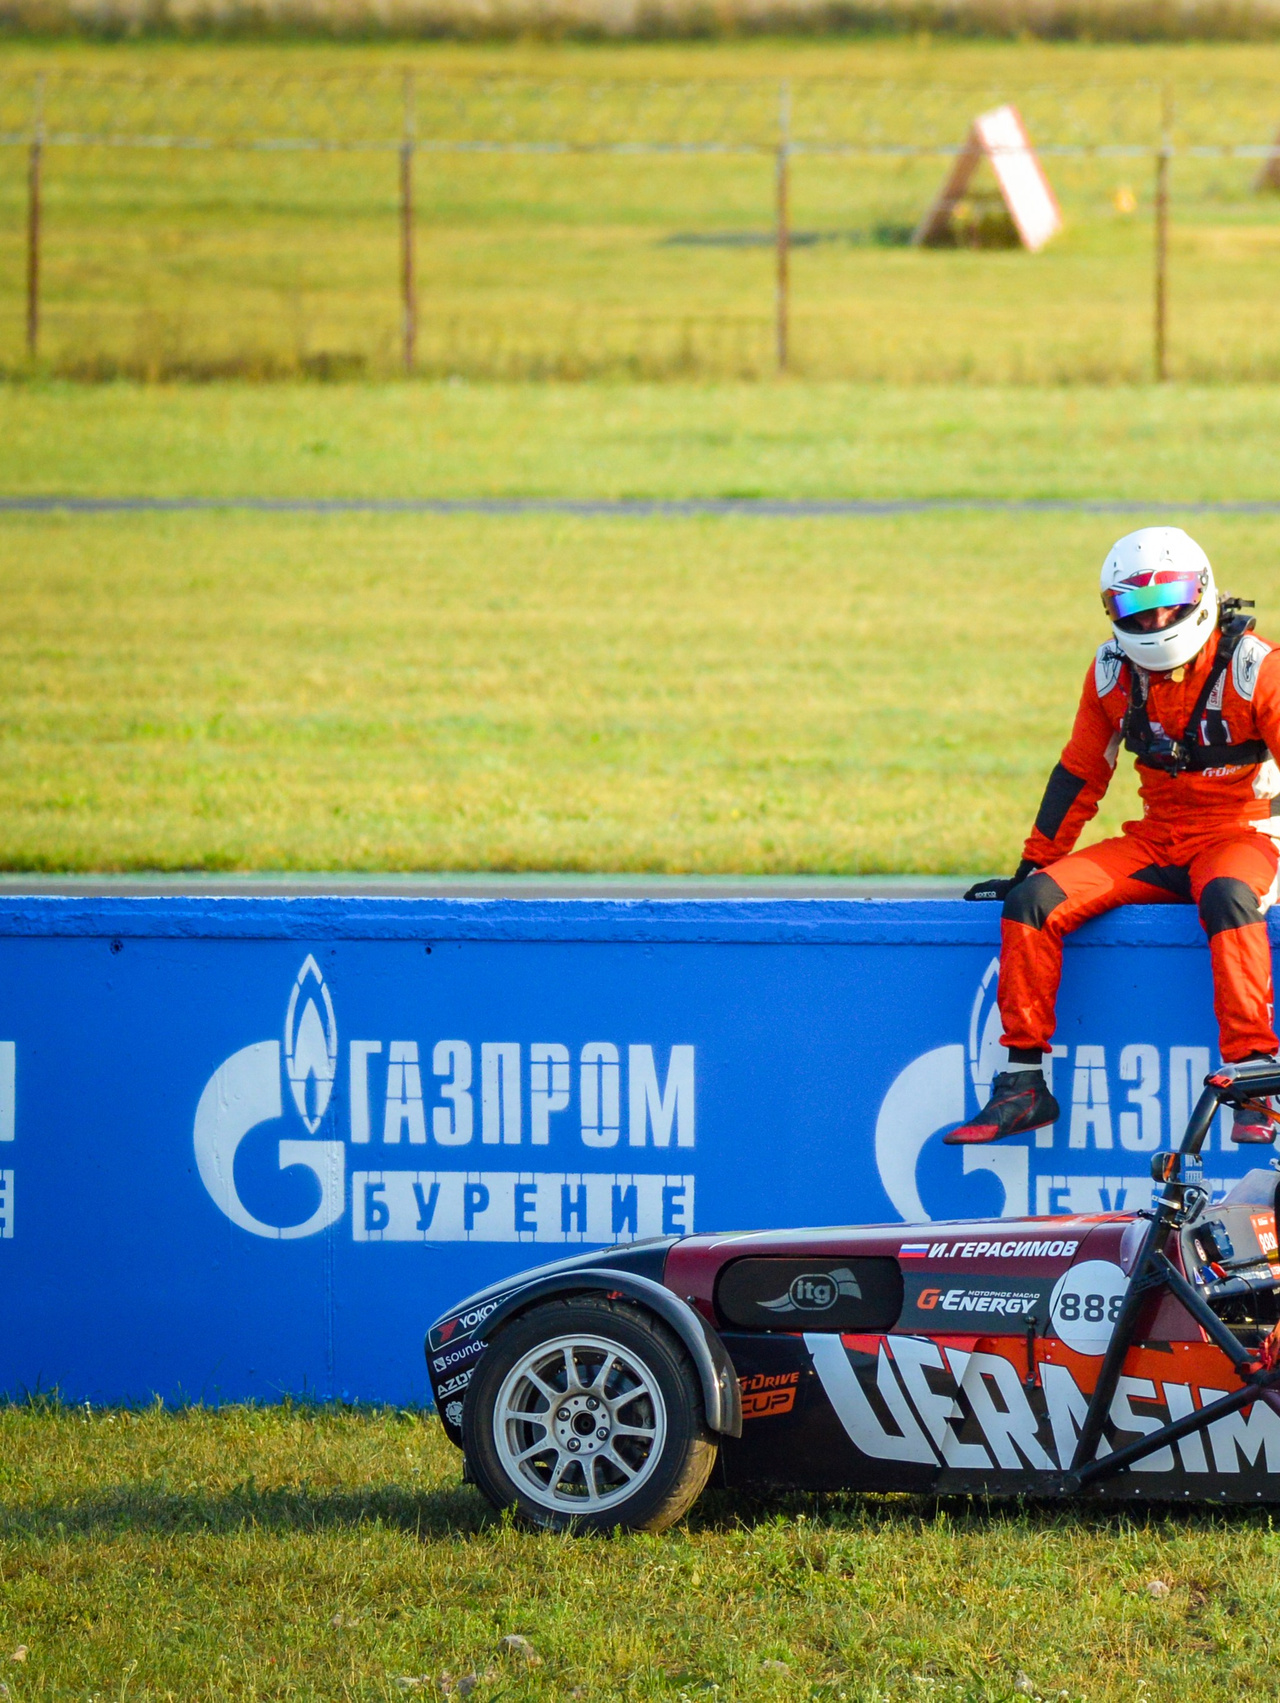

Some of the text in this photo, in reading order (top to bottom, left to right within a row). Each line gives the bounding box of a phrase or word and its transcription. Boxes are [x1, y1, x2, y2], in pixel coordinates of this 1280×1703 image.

[349, 1040, 695, 1148] ГАЗПРОМ
[364, 1181, 687, 1236] БУРЕНИЕ
[928, 1240, 1079, 1258] И.ГЕРАСИМОВ
[796, 1280, 831, 1305] itg
[968, 1289, 1012, 1298] МОТОРНОЕ
[459, 1299, 504, 1329] YOKO
[741, 1393, 790, 1414] CUP
